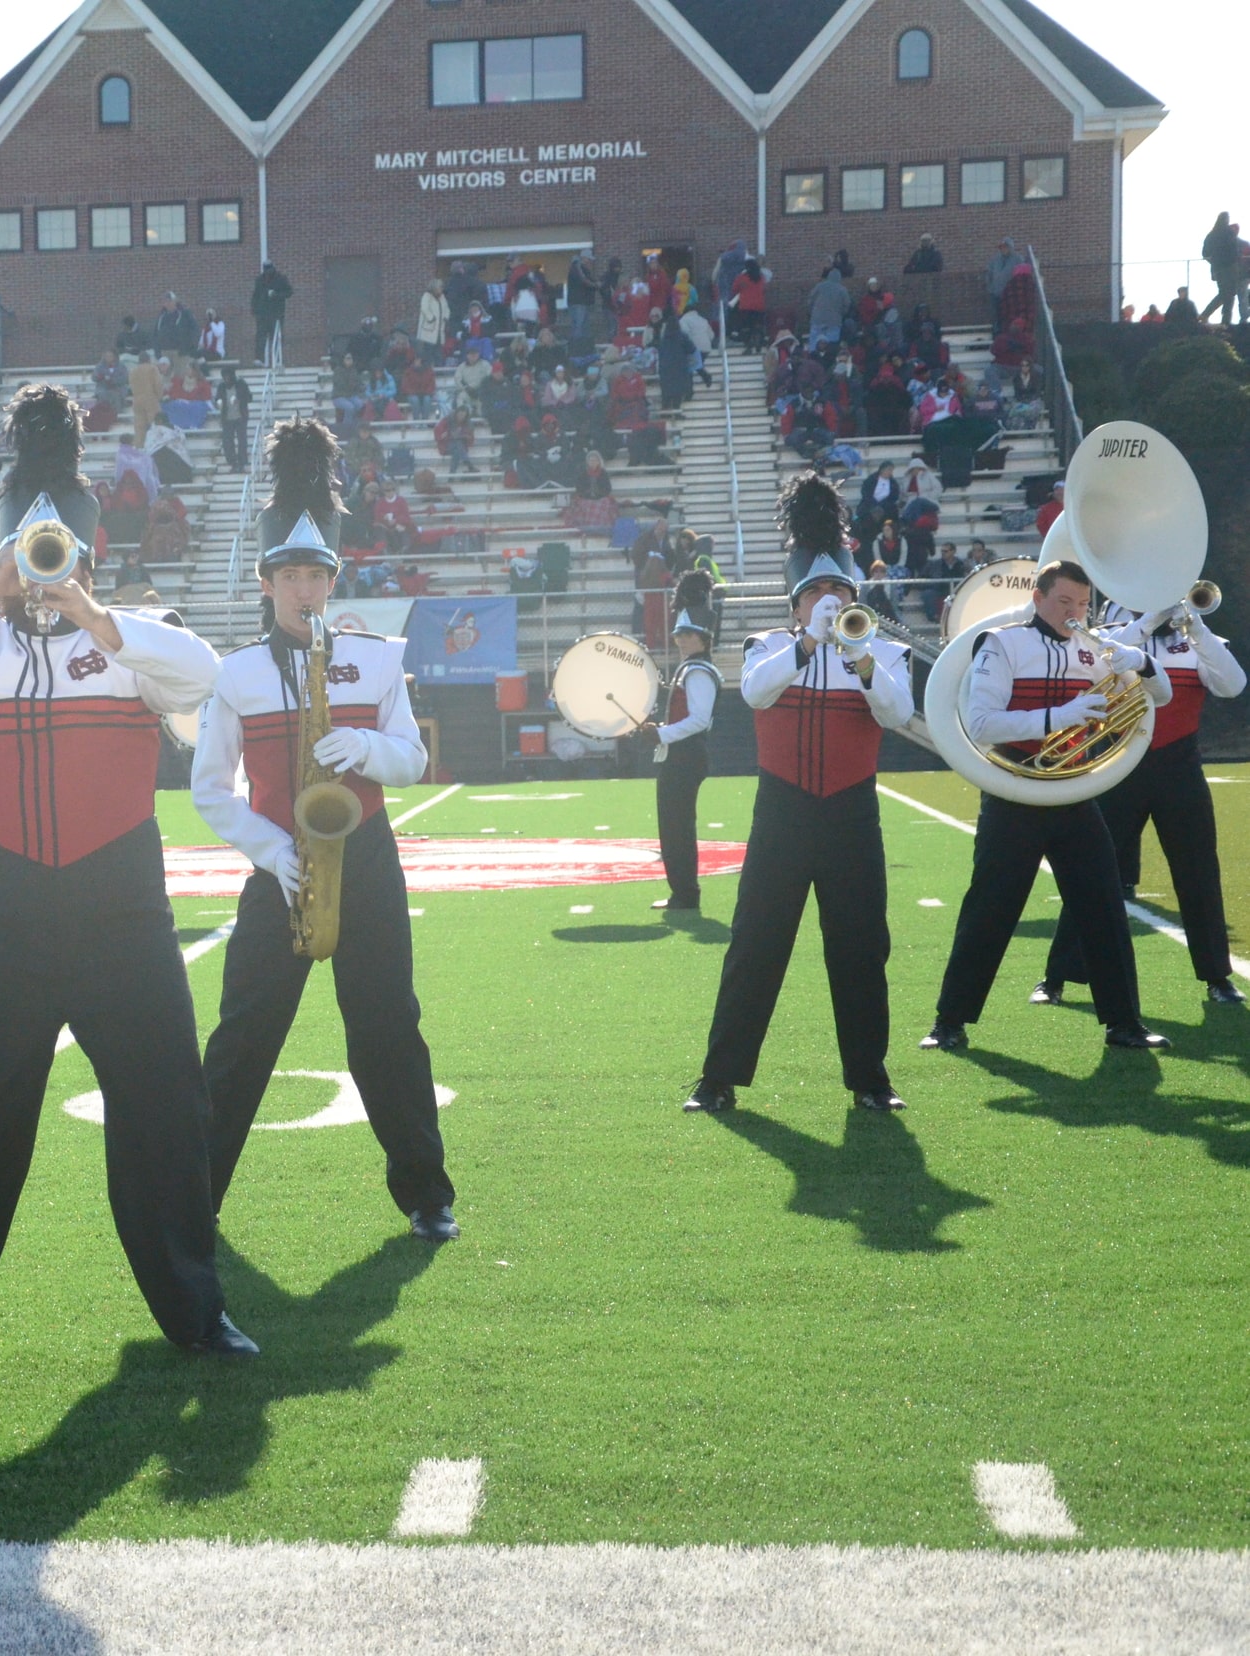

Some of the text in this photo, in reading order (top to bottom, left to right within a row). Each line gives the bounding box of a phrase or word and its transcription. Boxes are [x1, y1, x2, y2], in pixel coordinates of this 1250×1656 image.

[374, 140, 648, 169] MARY MITCHELL MEMORIAL
[418, 166, 596, 190] VISITORS CENTER
[1098, 438, 1149, 458] JUPITER
[606, 644, 645, 669] YAMAHA
